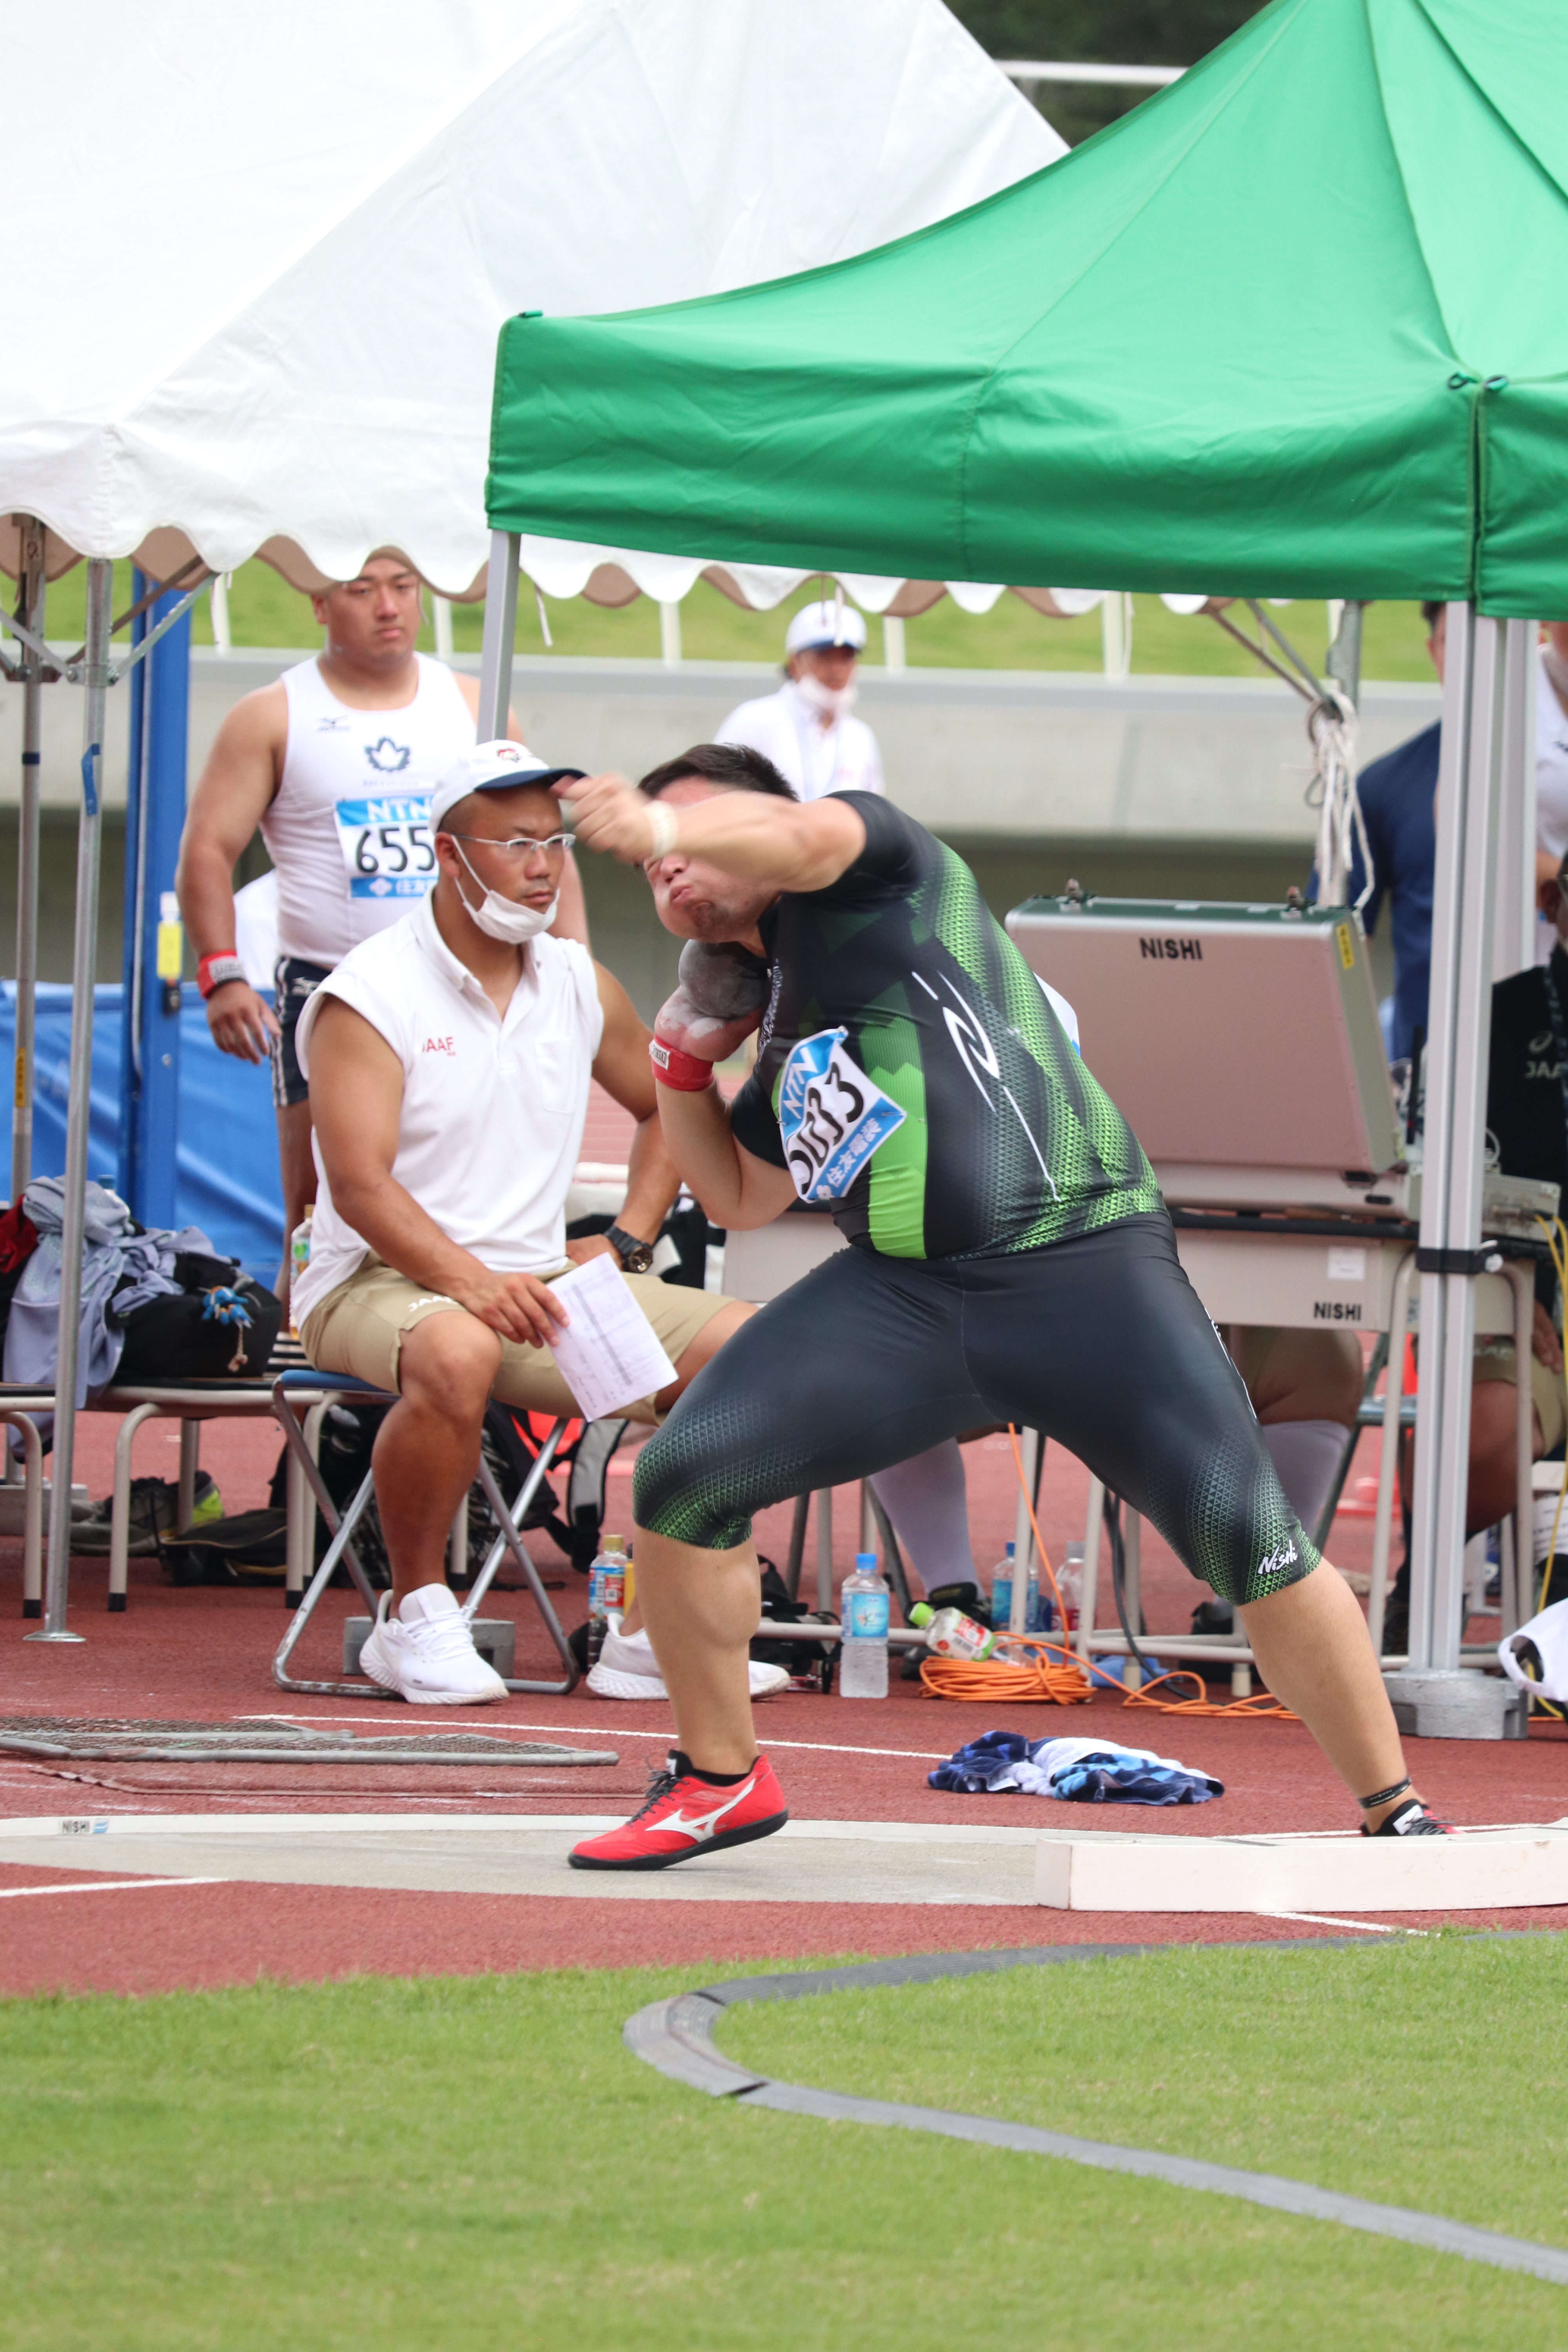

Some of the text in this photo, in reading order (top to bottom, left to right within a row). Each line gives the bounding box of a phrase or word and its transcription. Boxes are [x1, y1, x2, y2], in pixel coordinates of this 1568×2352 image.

[367, 797, 433, 822] NTN
[356, 826, 436, 873] 655
[1140, 937, 1202, 960] NISHI
[783, 1047, 818, 1119] NTN
[826, 1117, 882, 1188] 住友電装
[1314, 1301, 1361, 1322] NISHI
[62, 1820, 90, 1833] NISHI
